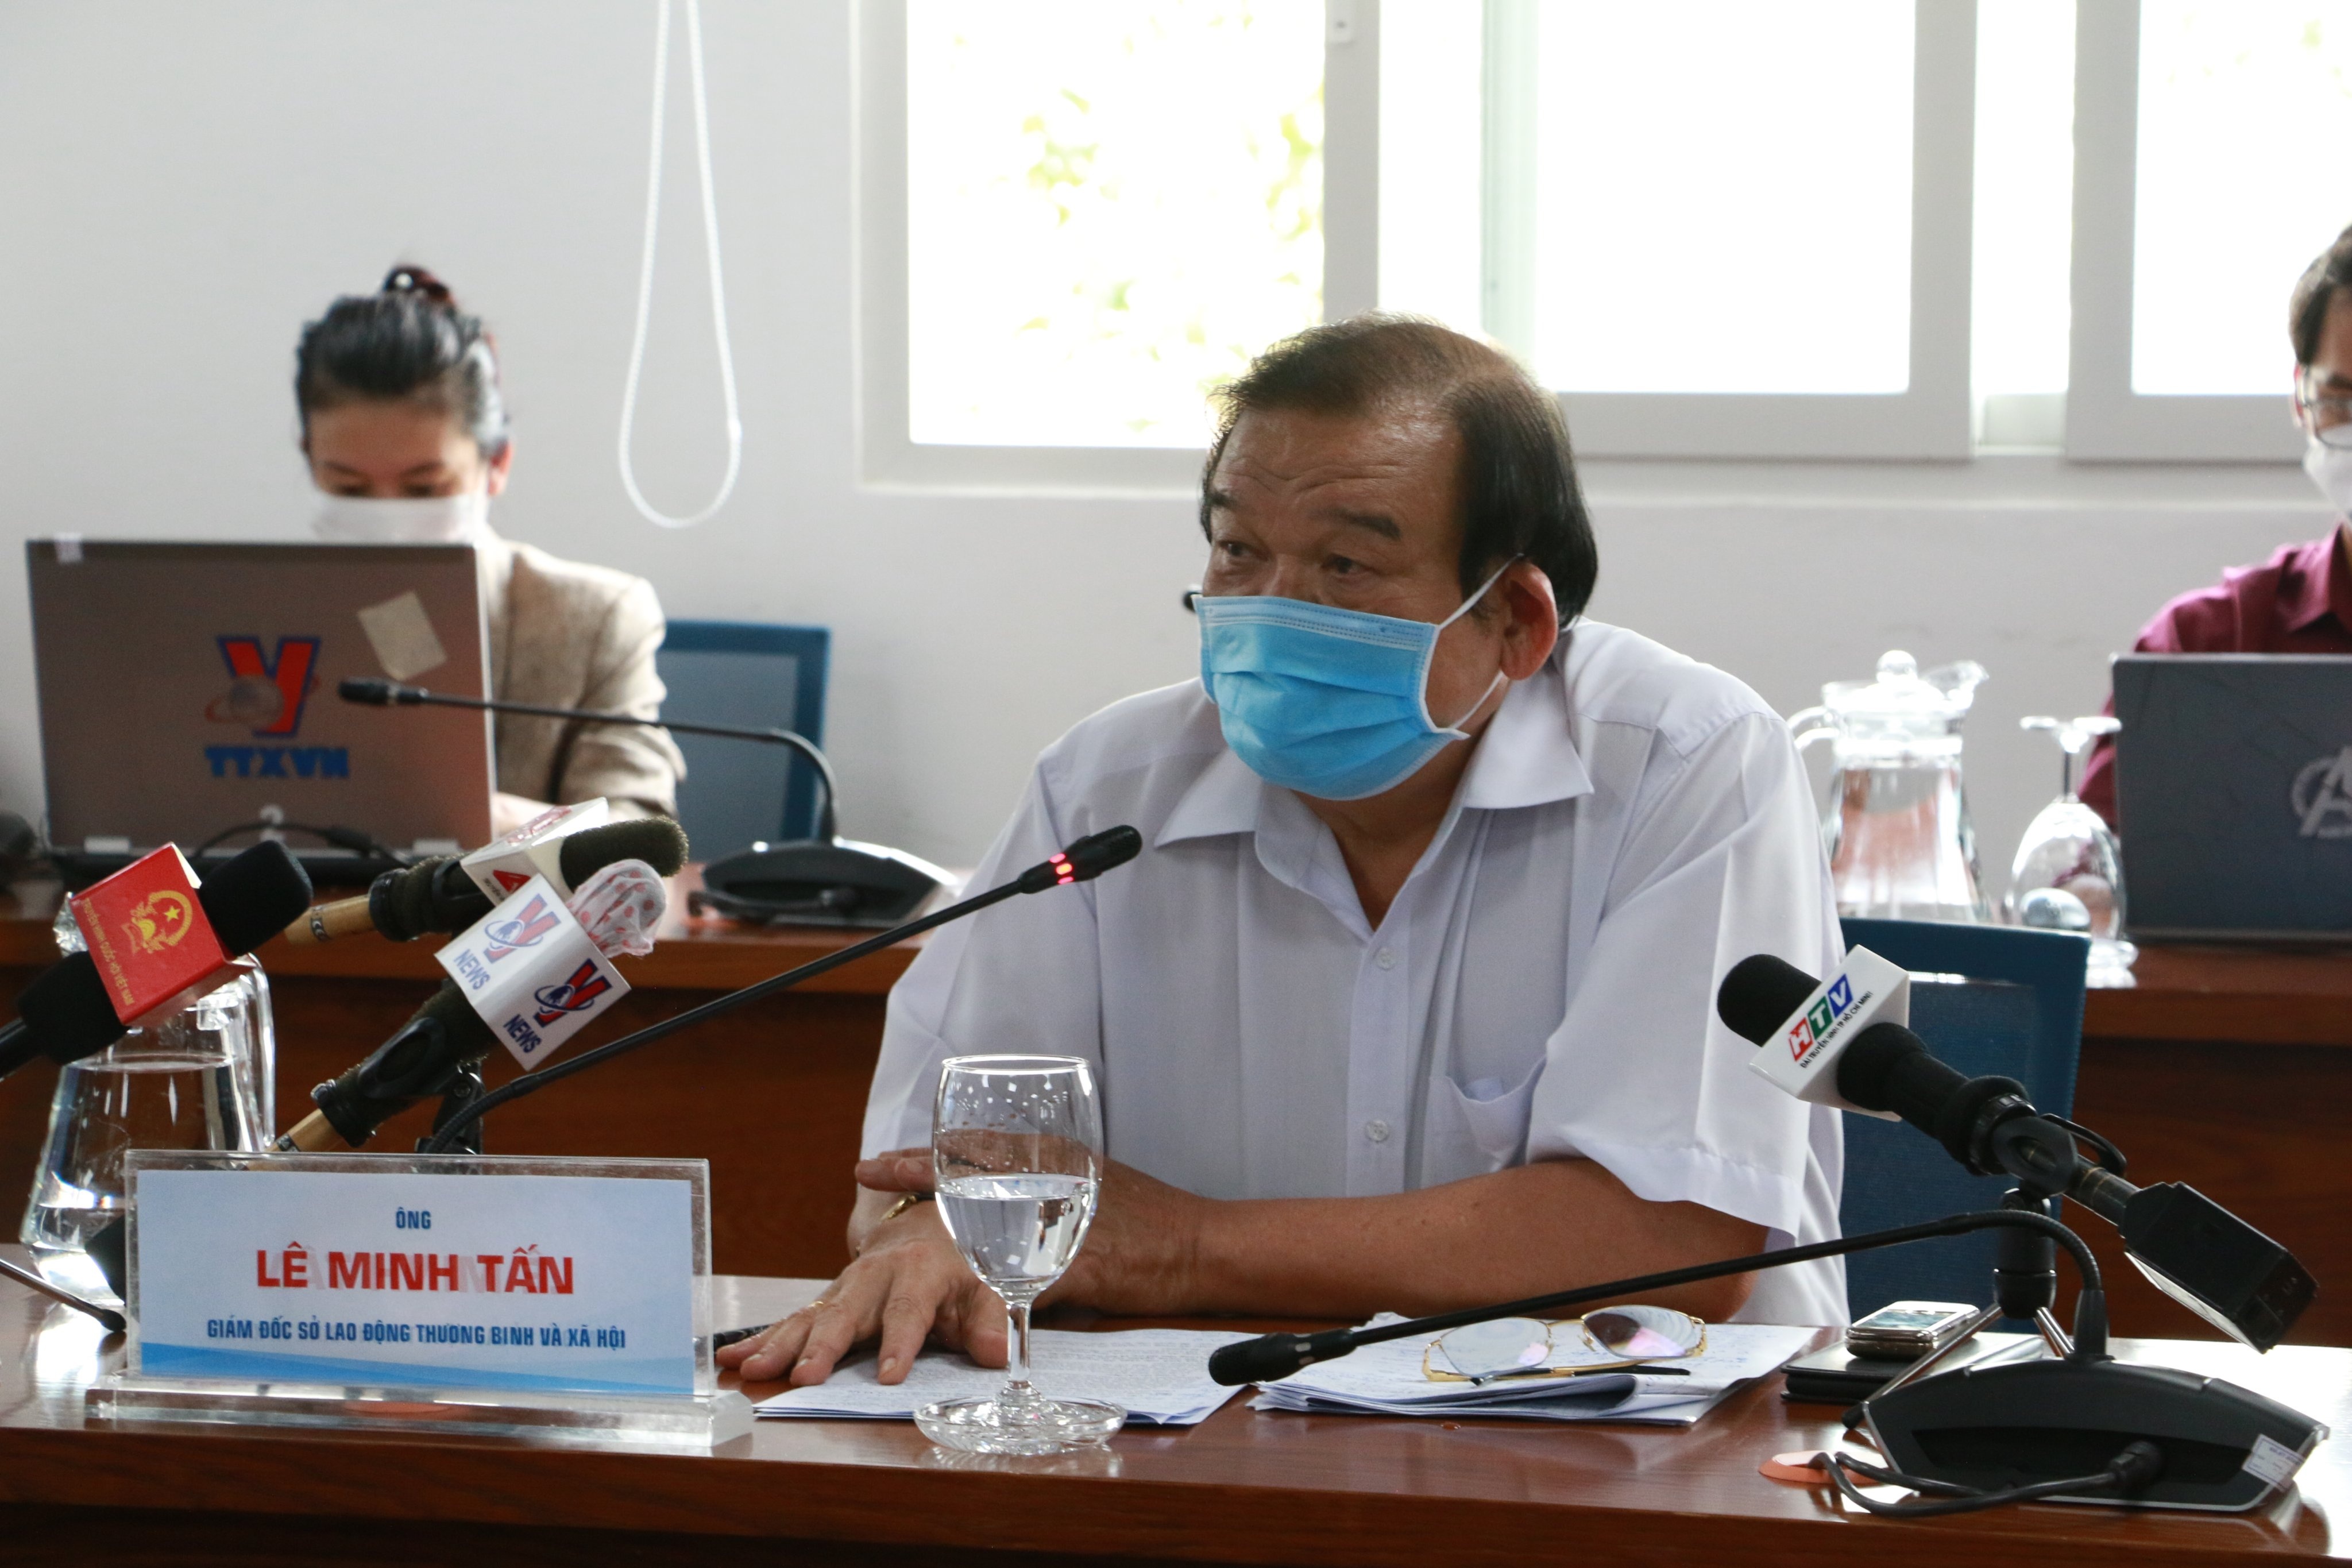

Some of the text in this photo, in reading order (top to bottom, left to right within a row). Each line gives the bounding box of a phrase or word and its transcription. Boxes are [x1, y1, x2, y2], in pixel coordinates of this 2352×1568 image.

[204, 746, 349, 778] TTXVN
[452, 948, 491, 991] NEWS
[121, 989, 134, 1005] NAM
[1841, 1012, 1853, 1024] HỒ
[1858, 990, 1874, 1006] MINH
[503, 1015, 542, 1053] NEWS
[1788, 973, 1853, 1062] HTV
[396, 1207, 431, 1229] ÔNG
[257, 1241, 573, 1295] LÊ MINH TẤN
[207, 1315, 253, 1339] GIÁM
[259, 1315, 292, 1339] ĐỐC
[298, 1315, 320, 1340] SỞ
[326, 1322, 356, 1341] LAO
[363, 1320, 411, 1345] ĐỘNG
[491, 1326, 534, 1346] BINH
[539, 1323, 562, 1346] VÀ
[569, 1324, 590, 1347] XÃ
[597, 1326, 626, 1350] HỘI
